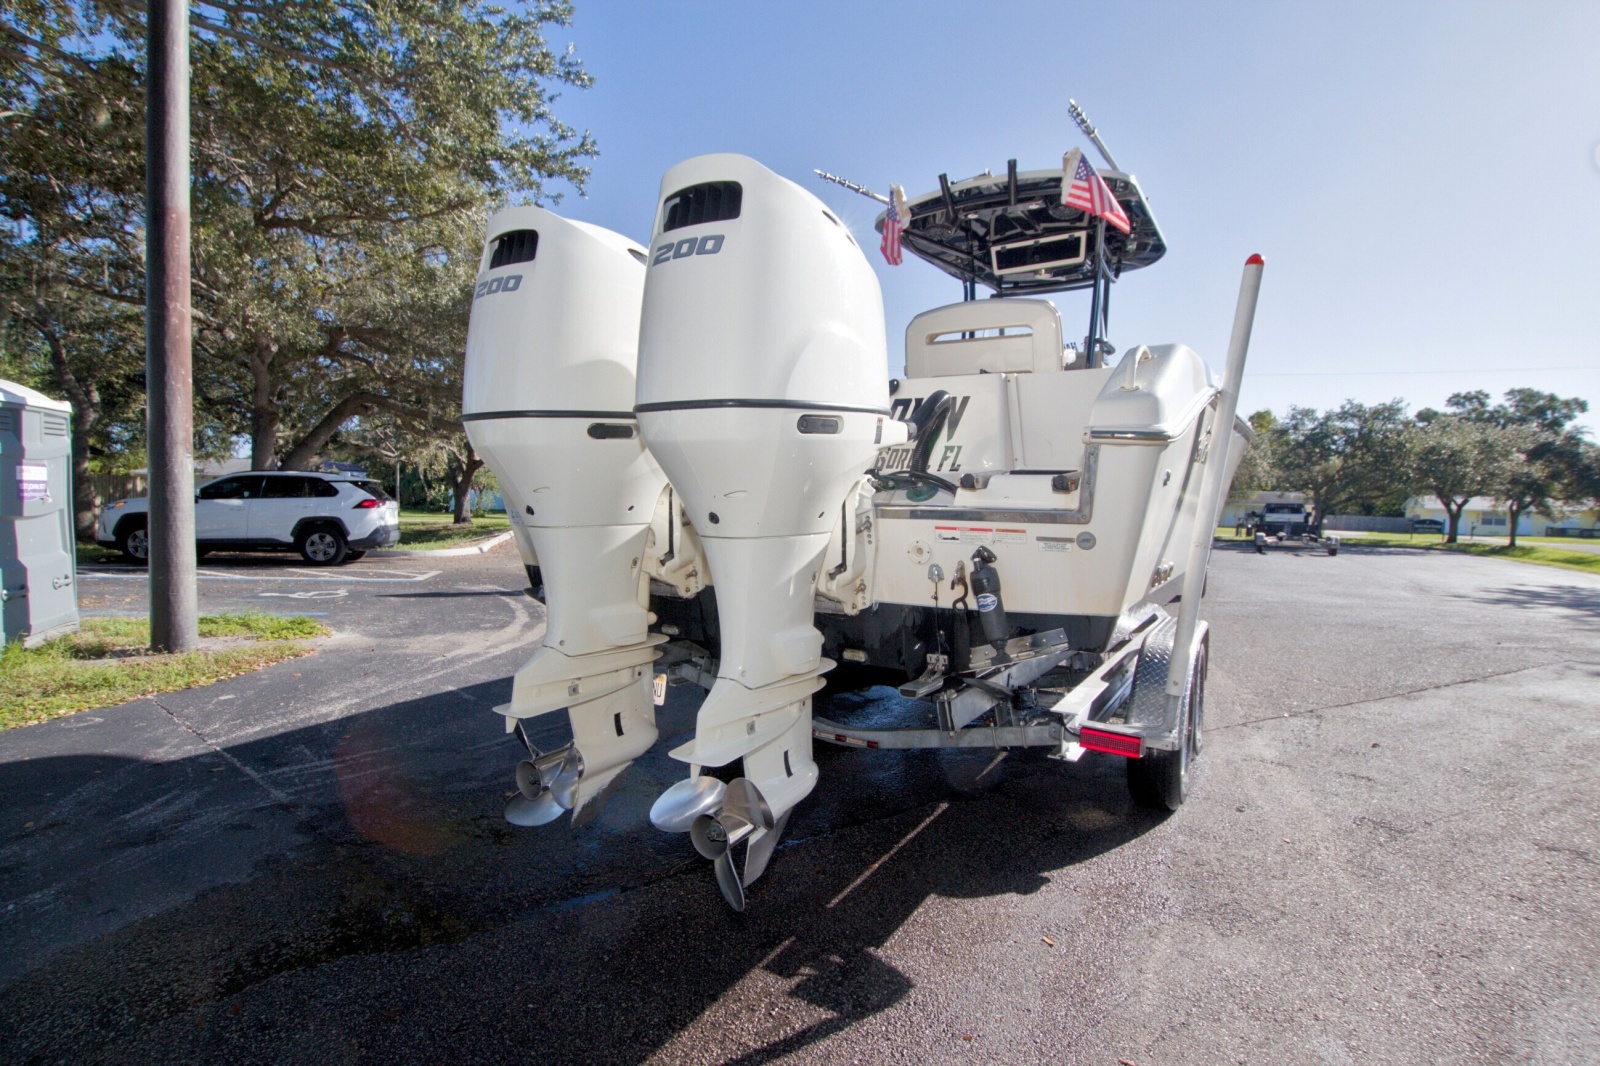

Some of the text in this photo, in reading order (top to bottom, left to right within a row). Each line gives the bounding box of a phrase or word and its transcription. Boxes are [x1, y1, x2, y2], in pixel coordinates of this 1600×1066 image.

[652, 234, 725, 266] 200
[475, 274, 523, 300] 200
[937, 445, 963, 472] FL
